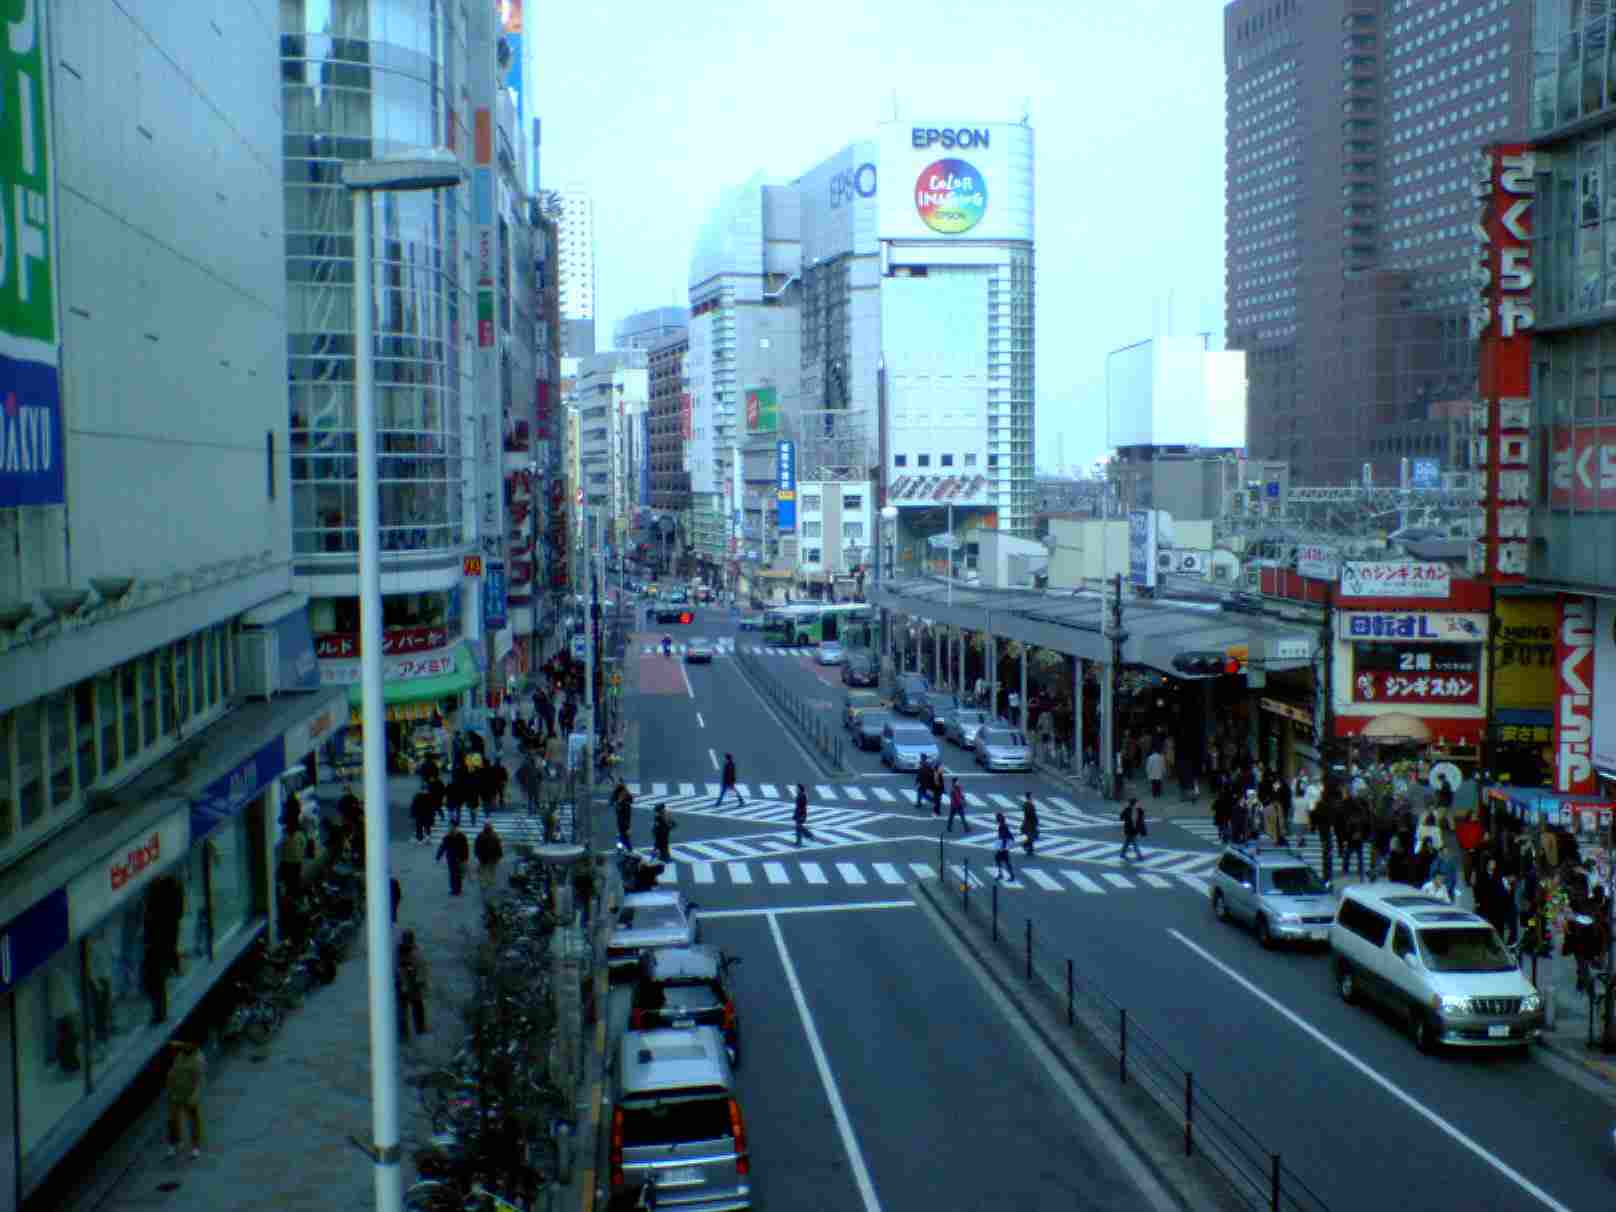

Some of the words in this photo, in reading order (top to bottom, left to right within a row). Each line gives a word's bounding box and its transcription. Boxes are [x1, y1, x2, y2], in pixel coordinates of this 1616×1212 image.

[911, 127, 990, 149] EPSON
[1501, 152, 1536, 337] さくらや
[1385, 676, 1473, 696] ジンギスカン
[1559, 603, 1593, 791] さくらや
